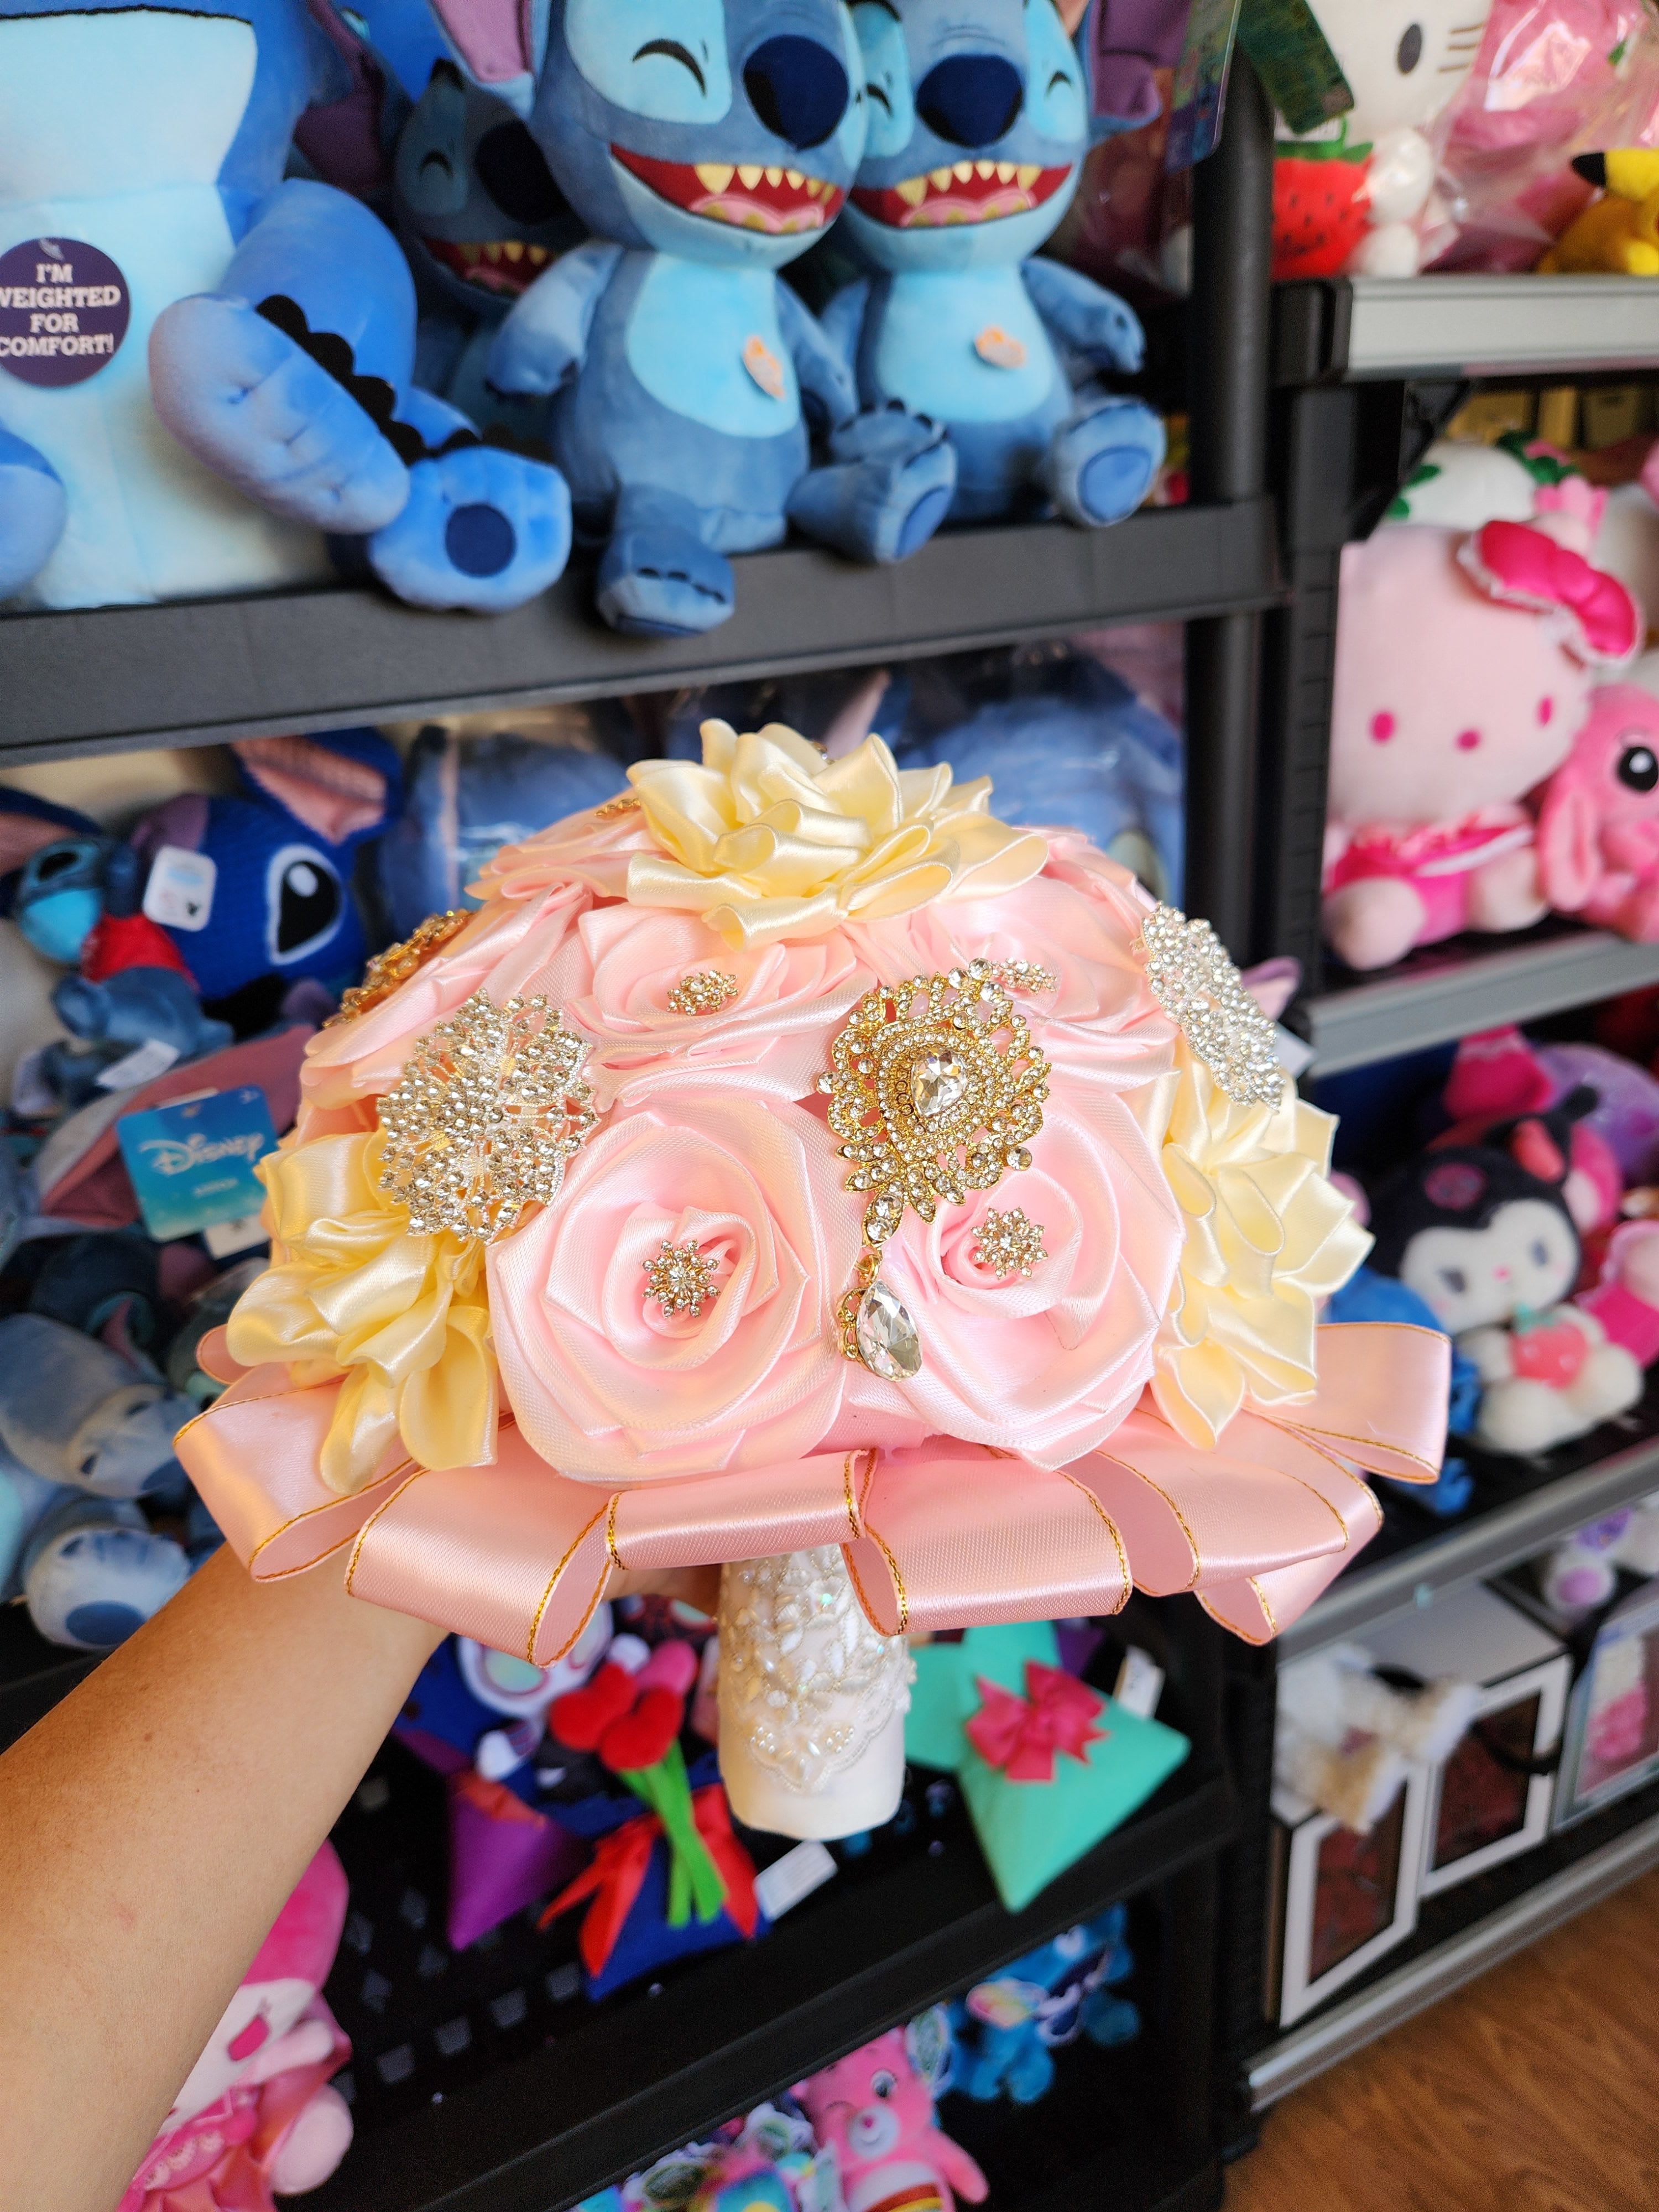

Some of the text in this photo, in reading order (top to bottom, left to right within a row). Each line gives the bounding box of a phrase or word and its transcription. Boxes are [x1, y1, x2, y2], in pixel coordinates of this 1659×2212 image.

[36, 263, 74, 283] I'M
[30, 313, 80, 333] FOR
[0, 333, 114, 357] COMFORT!
[139, 1133, 265, 1176] Disney
